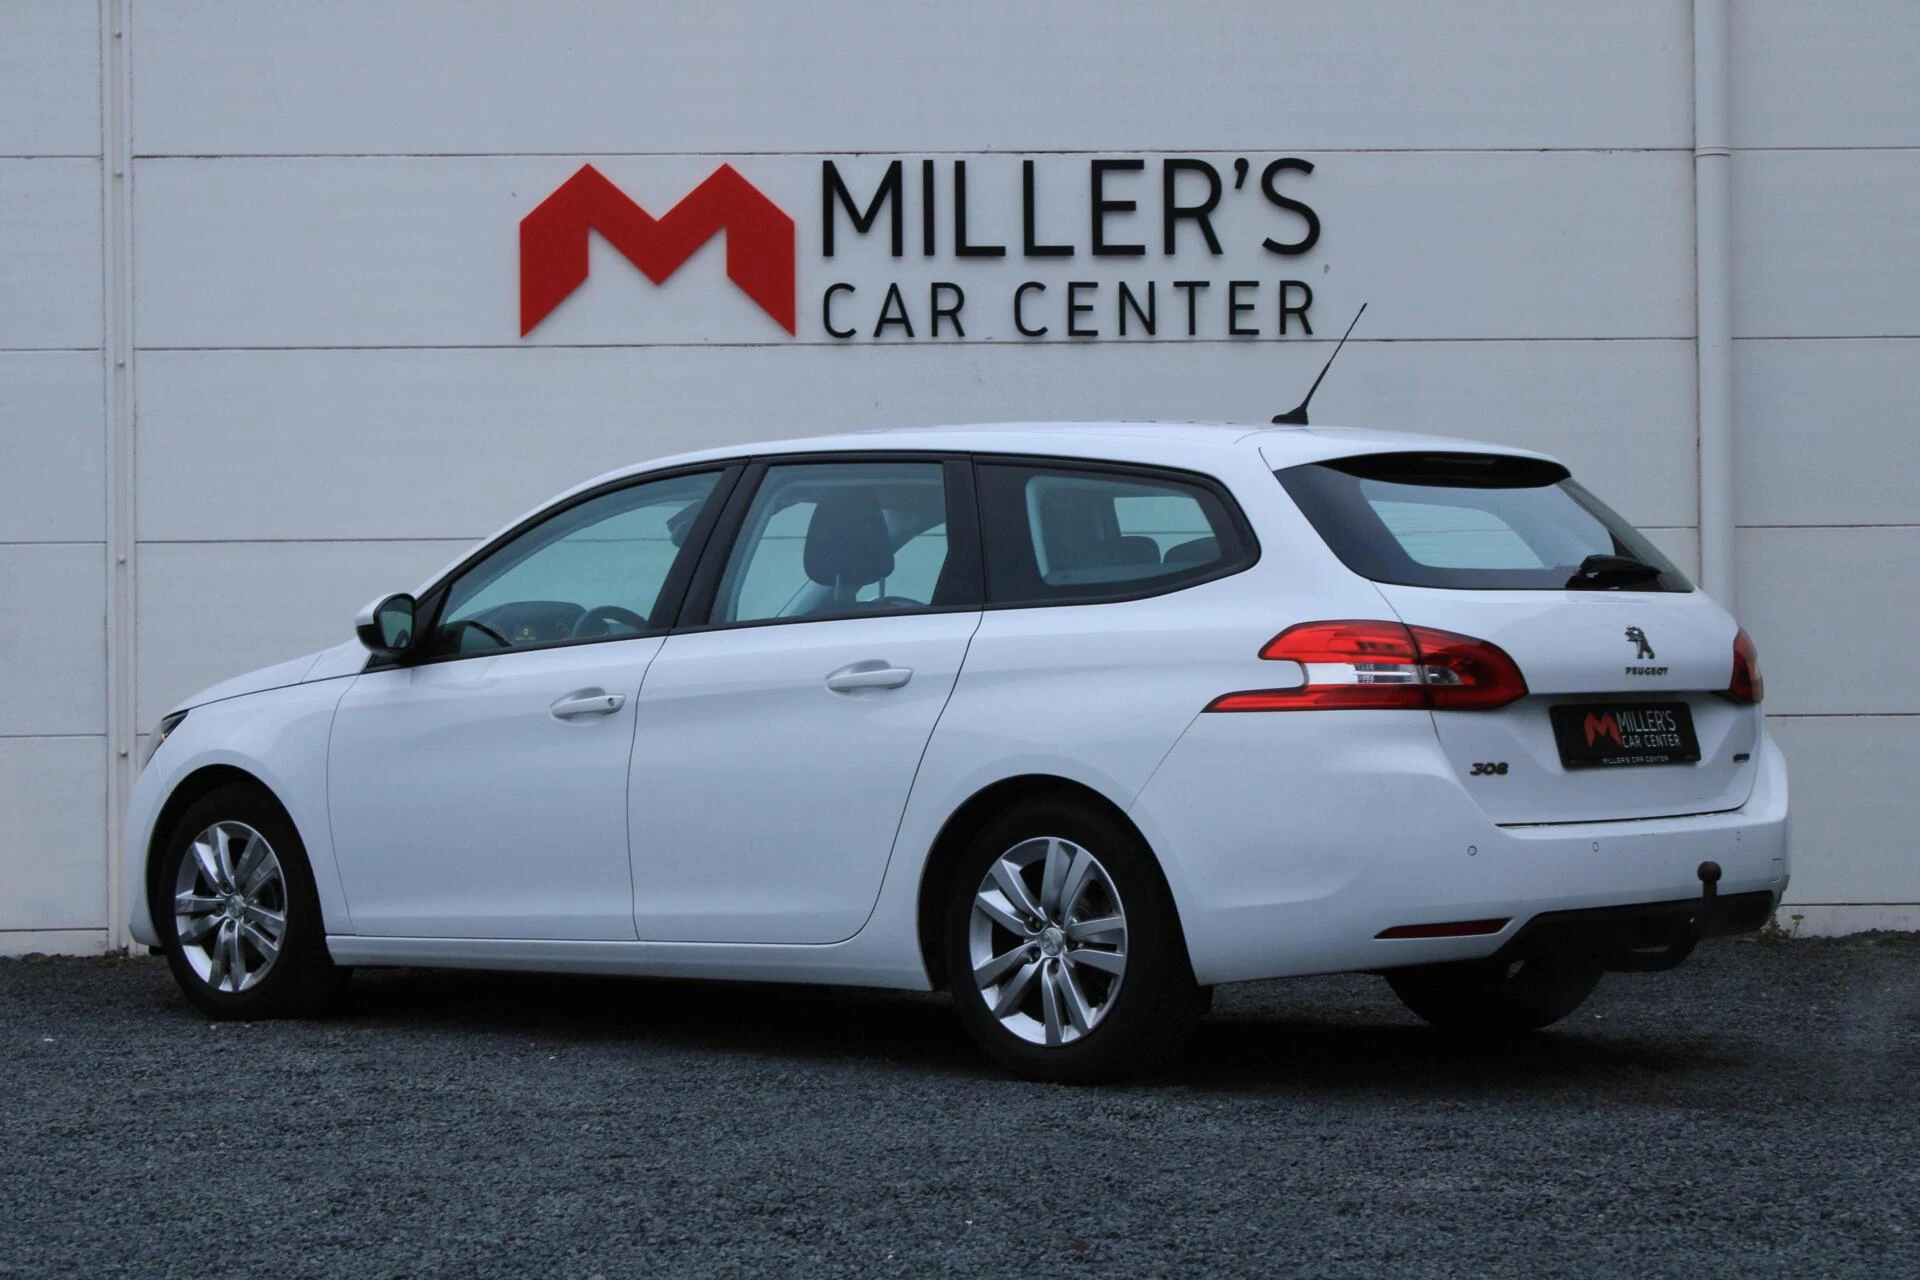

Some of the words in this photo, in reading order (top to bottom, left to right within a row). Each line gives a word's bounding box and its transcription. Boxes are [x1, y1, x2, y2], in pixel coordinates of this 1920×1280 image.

[822, 157, 1321, 259] MILLER'S
[822, 281, 967, 340] CAR
[1013, 279, 1315, 338] CENTER
[1625, 666, 1669, 676] PEUGEOT
[1616, 710, 1677, 733] MILLER'S
[1622, 735, 1642, 748] CAR
[1644, 733, 1681, 748] CENTER
[1469, 761, 1509, 777] 308
